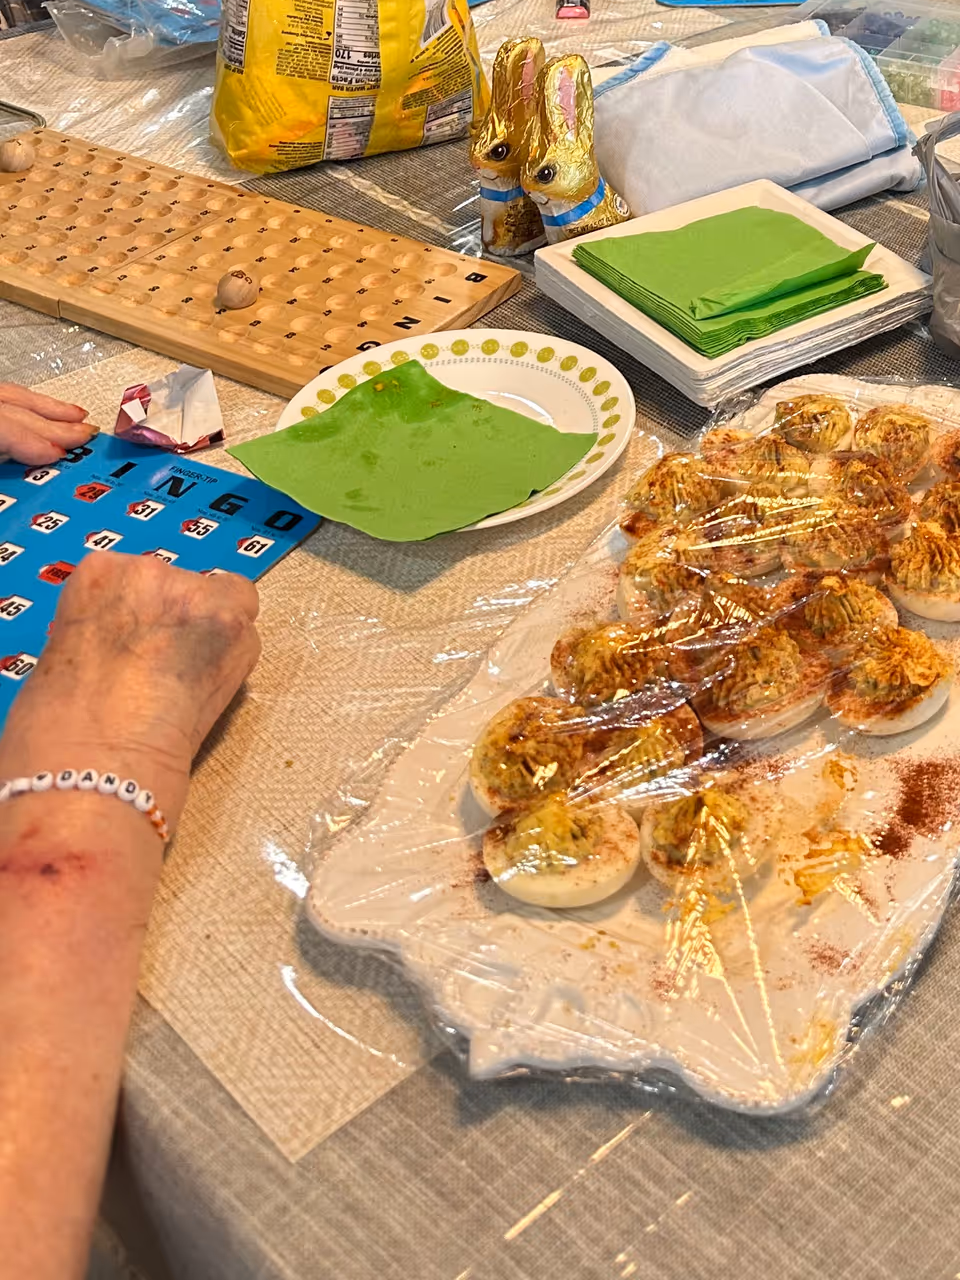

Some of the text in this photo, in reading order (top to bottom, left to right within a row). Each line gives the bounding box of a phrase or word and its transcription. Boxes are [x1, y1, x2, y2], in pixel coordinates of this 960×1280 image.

[335, 49, 351, 60] 170
[331, 75, 353, 85] Facts
[32, 469, 50, 481] 3
[169, 465, 219, 485] FINGER-TIP
[133, 501, 158, 517] 31
[35, 516, 64, 531] 25
[187, 520, 214, 536] 55
[92, 534, 117, 549] 41
[243, 539, 270, 555] 61
[0, 600, 26, 616] 45
[7, 657, 35, 676] 60
[60, 770, 153, 804] DANDY
